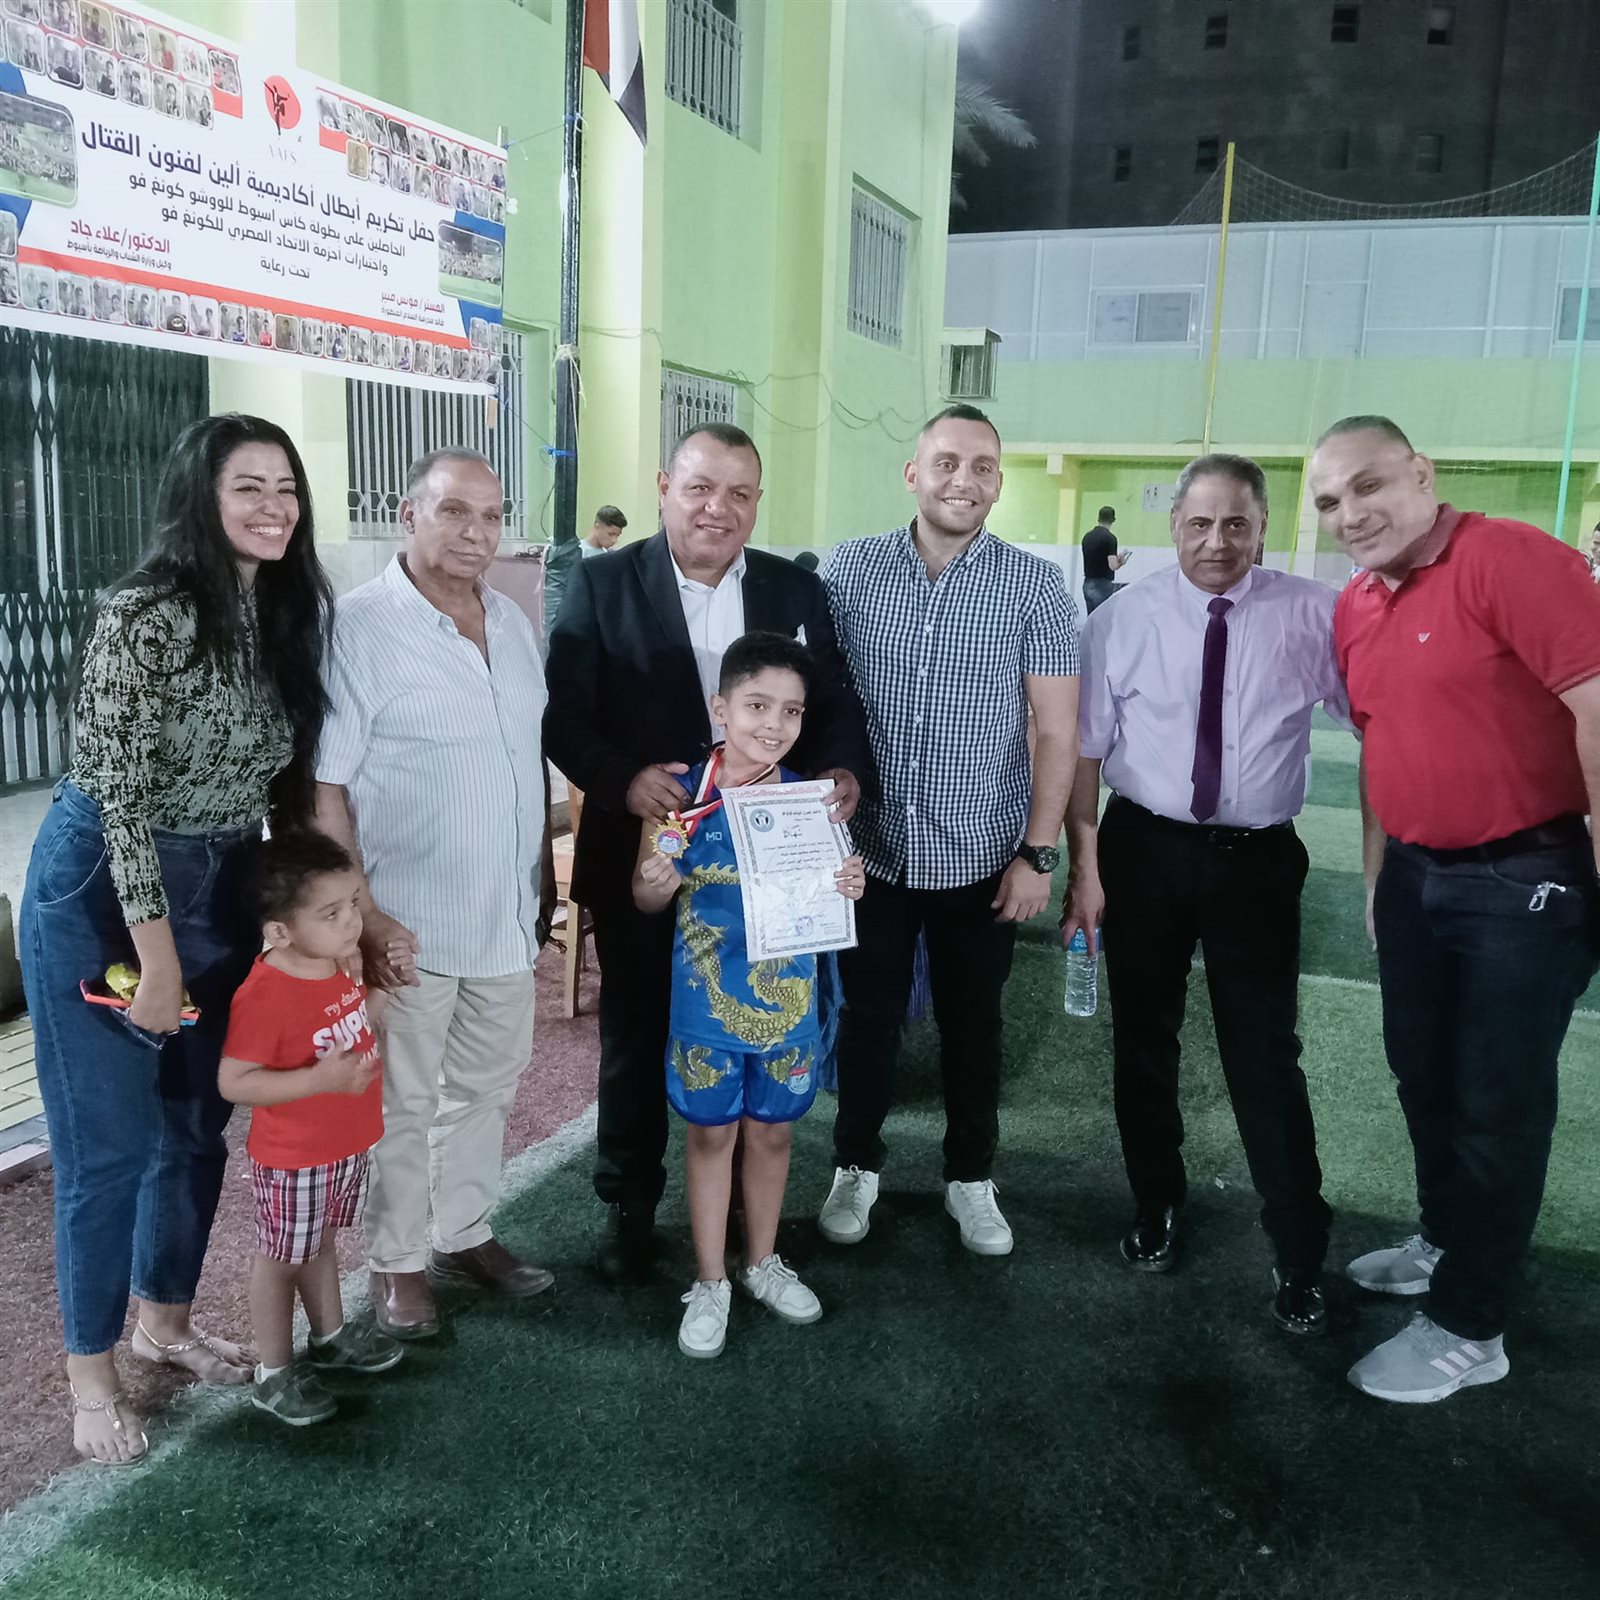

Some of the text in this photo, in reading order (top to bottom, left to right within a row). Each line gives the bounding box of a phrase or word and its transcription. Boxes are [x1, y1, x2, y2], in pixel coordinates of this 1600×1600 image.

[81, 121, 436, 243] حفل تكريم أبطال أكاديمية ألين لفنون القتال
[128, 172, 147, 190] فو
[151, 175, 185, 199] كونغ
[189, 187, 234, 213] للووشو
[161, 204, 178, 223] فو
[182, 208, 224, 232] للكونغ
[227, 226, 273, 244] المصري
[309, 221, 341, 241] بطولة
[276, 233, 311, 253] الاتحاد
[367, 238, 406, 257] الحاصلين
[259, 255, 311, 279] تحت رعاية
[344, 253, 389, 277] واختبارات
[705, 831, 723, 842] MD
